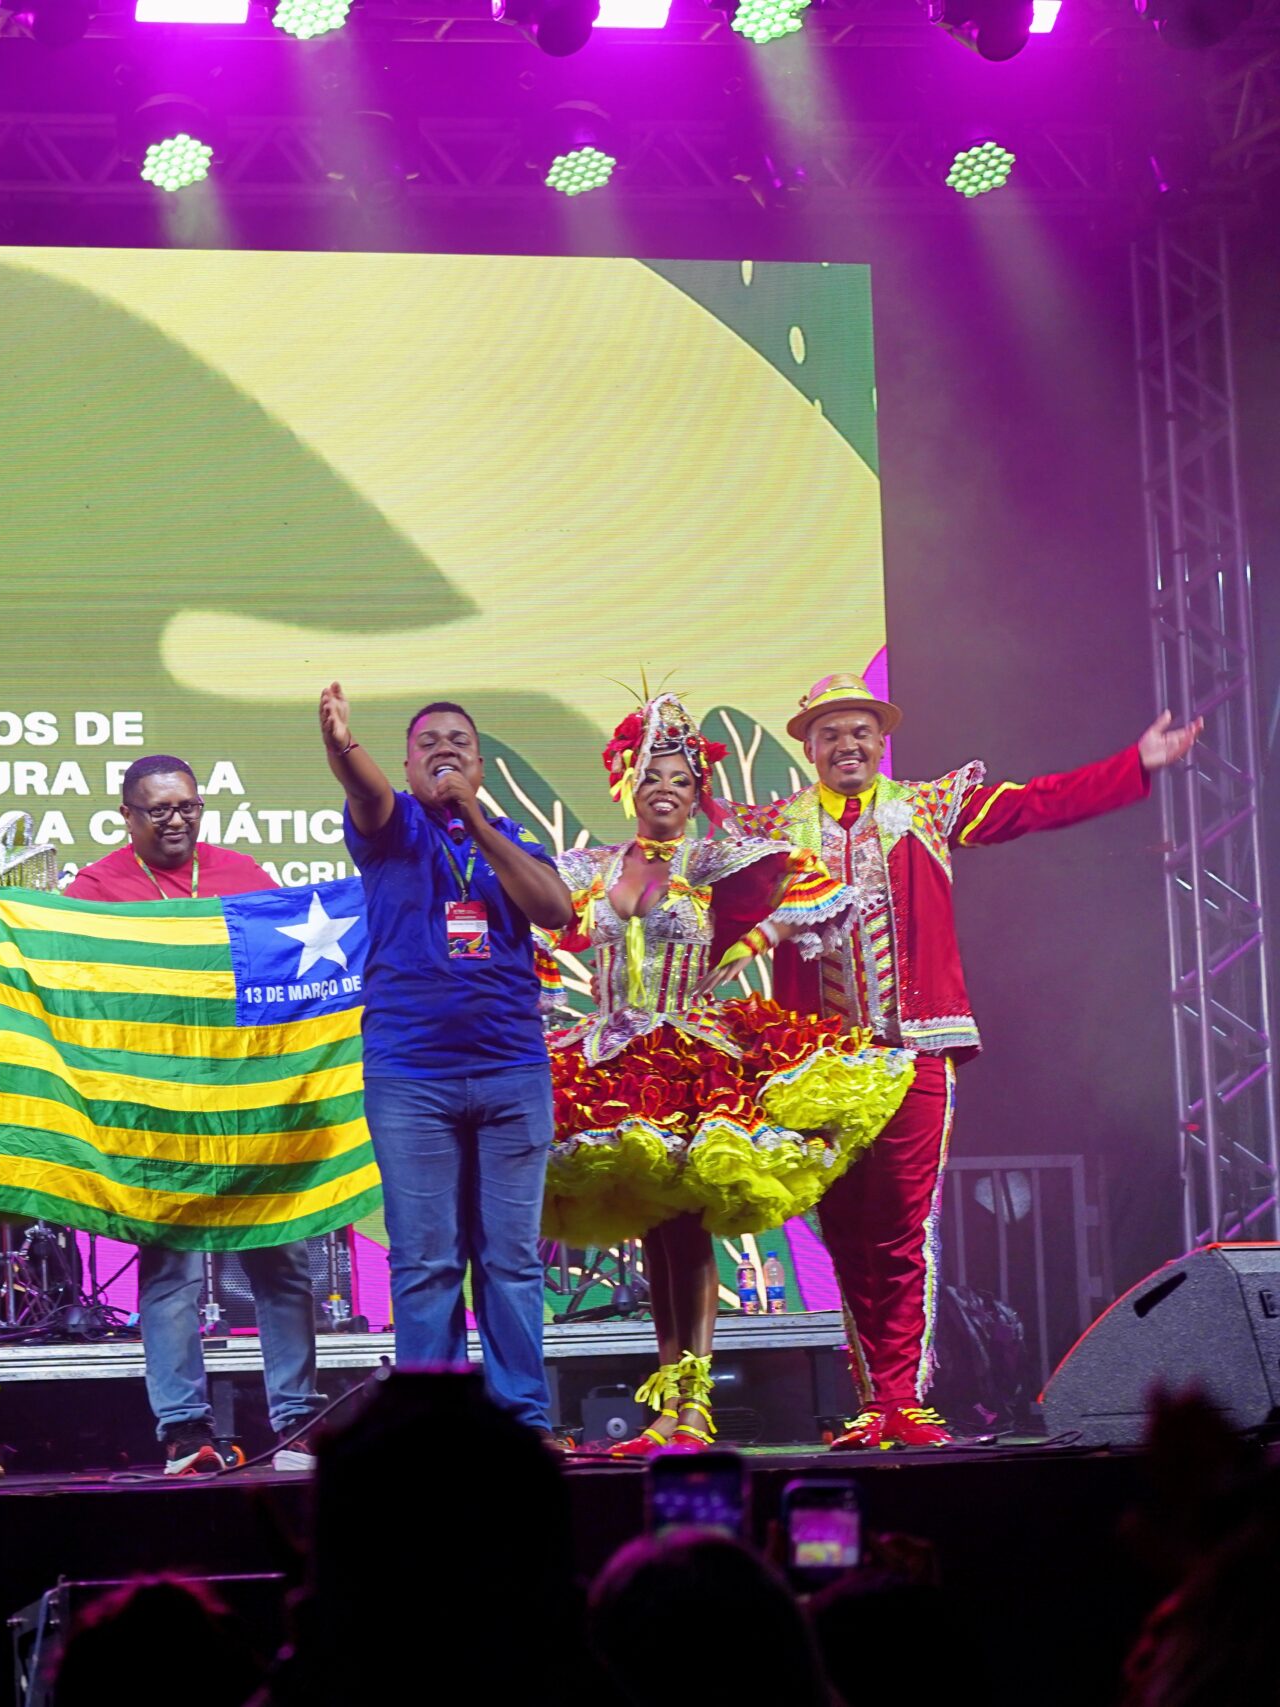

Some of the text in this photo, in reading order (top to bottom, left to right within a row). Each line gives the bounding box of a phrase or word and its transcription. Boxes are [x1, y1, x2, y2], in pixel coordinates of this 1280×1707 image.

[75, 711, 143, 746] DE
[244, 975, 362, 1003] 13 DE MARÇO DE
